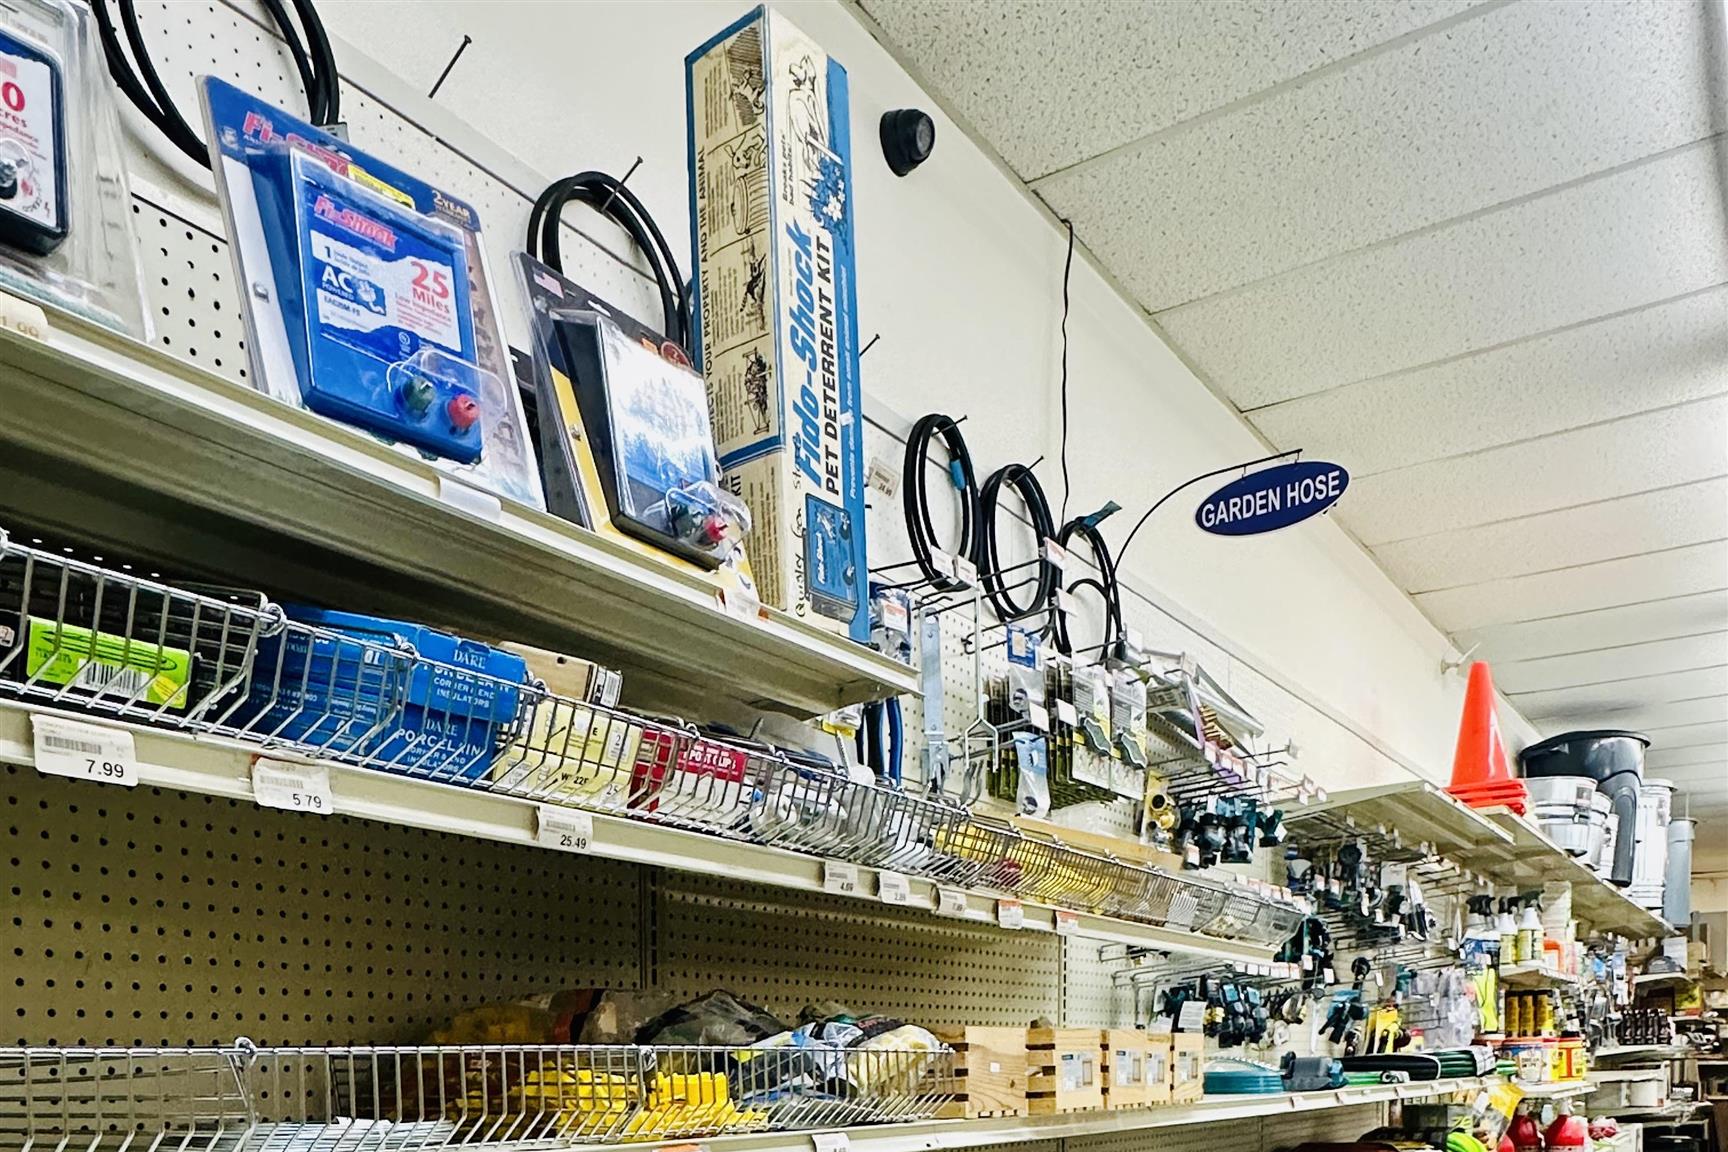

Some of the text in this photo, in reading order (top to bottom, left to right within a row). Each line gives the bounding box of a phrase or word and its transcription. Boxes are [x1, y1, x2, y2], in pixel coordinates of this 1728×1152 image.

[697, 147, 706, 200] ANIMAL
[700, 232, 708, 263] AND
[322, 265, 354, 294] AC
[410, 260, 449, 299] 25
[413, 287, 450, 314] Miles
[701, 270, 711, 337] PROPERTY
[704, 342, 713, 379] YOUR
[786, 216, 822, 488] Fido-Shock
[816, 235, 840, 496] PET DETERRENT KIT
[731, 475, 742, 496] KIT
[1201, 470, 1340, 528] GARDEN HOSE
[453, 649, 487, 669] DARE
[86, 759, 124, 778] 7.99
[292, 793, 322, 808] 5.79
[560, 834, 587, 849] 25.49
